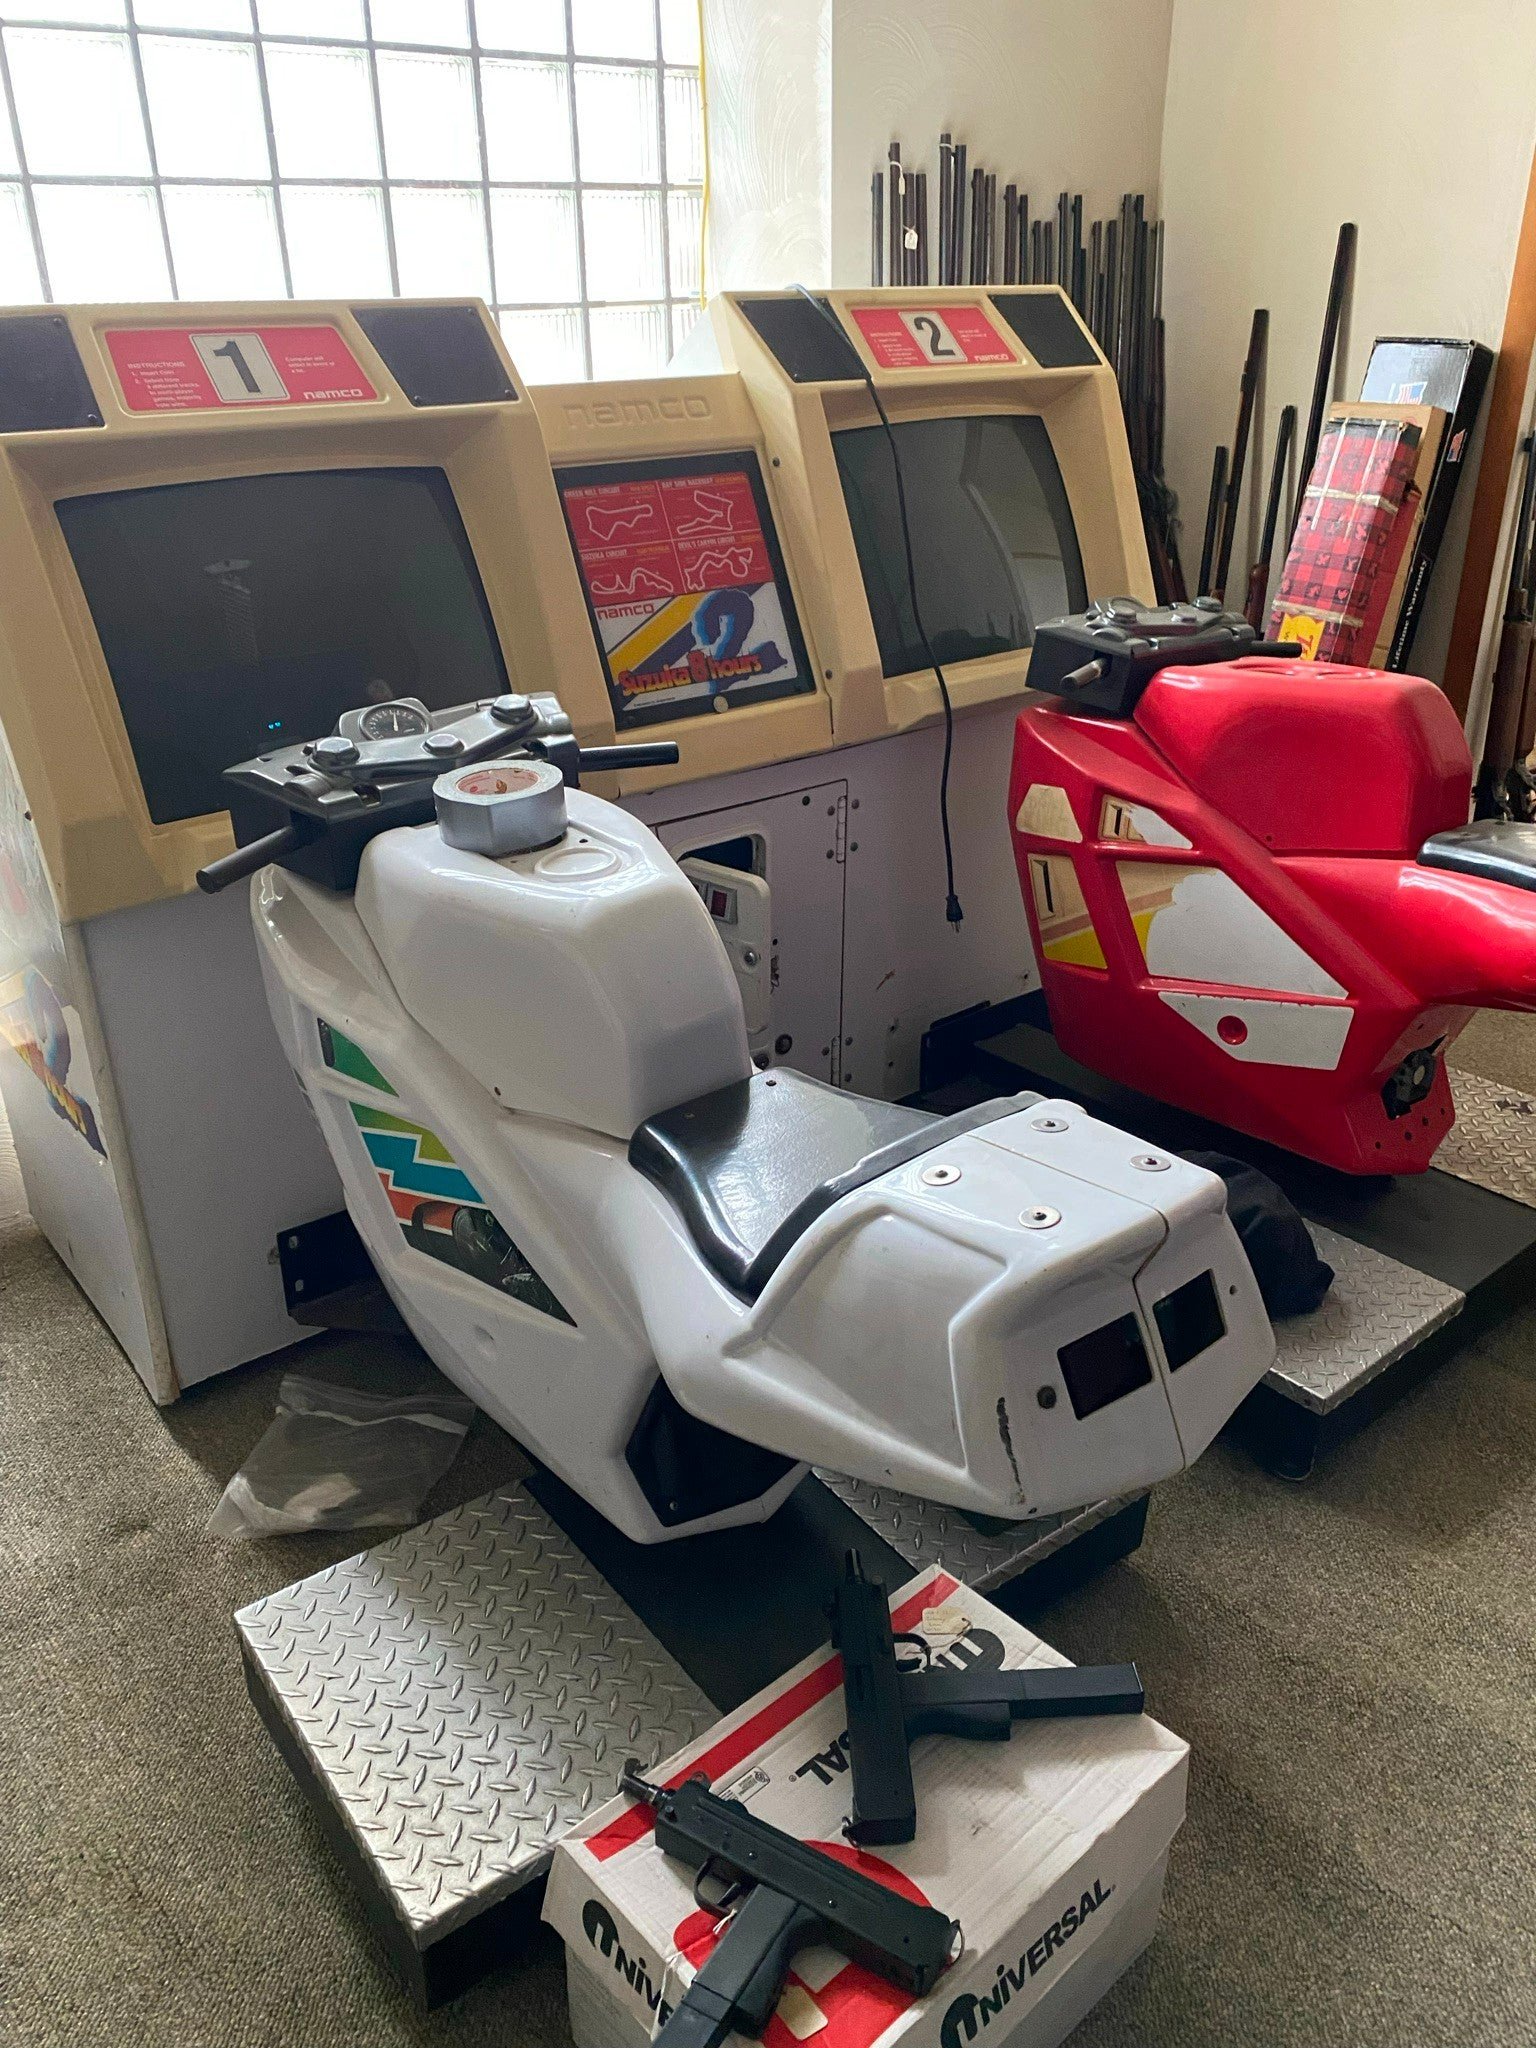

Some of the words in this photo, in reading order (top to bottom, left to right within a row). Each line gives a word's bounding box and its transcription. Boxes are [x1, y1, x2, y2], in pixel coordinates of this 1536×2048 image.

[914, 316, 955, 356] 2
[211, 340, 262, 393] 1
[973, 353, 1009, 362] namco
[303, 388, 363, 400] namco
[561, 395, 712, 428] namco
[1406, 560, 1427, 617] Warranty
[597, 603, 655, 620] namco
